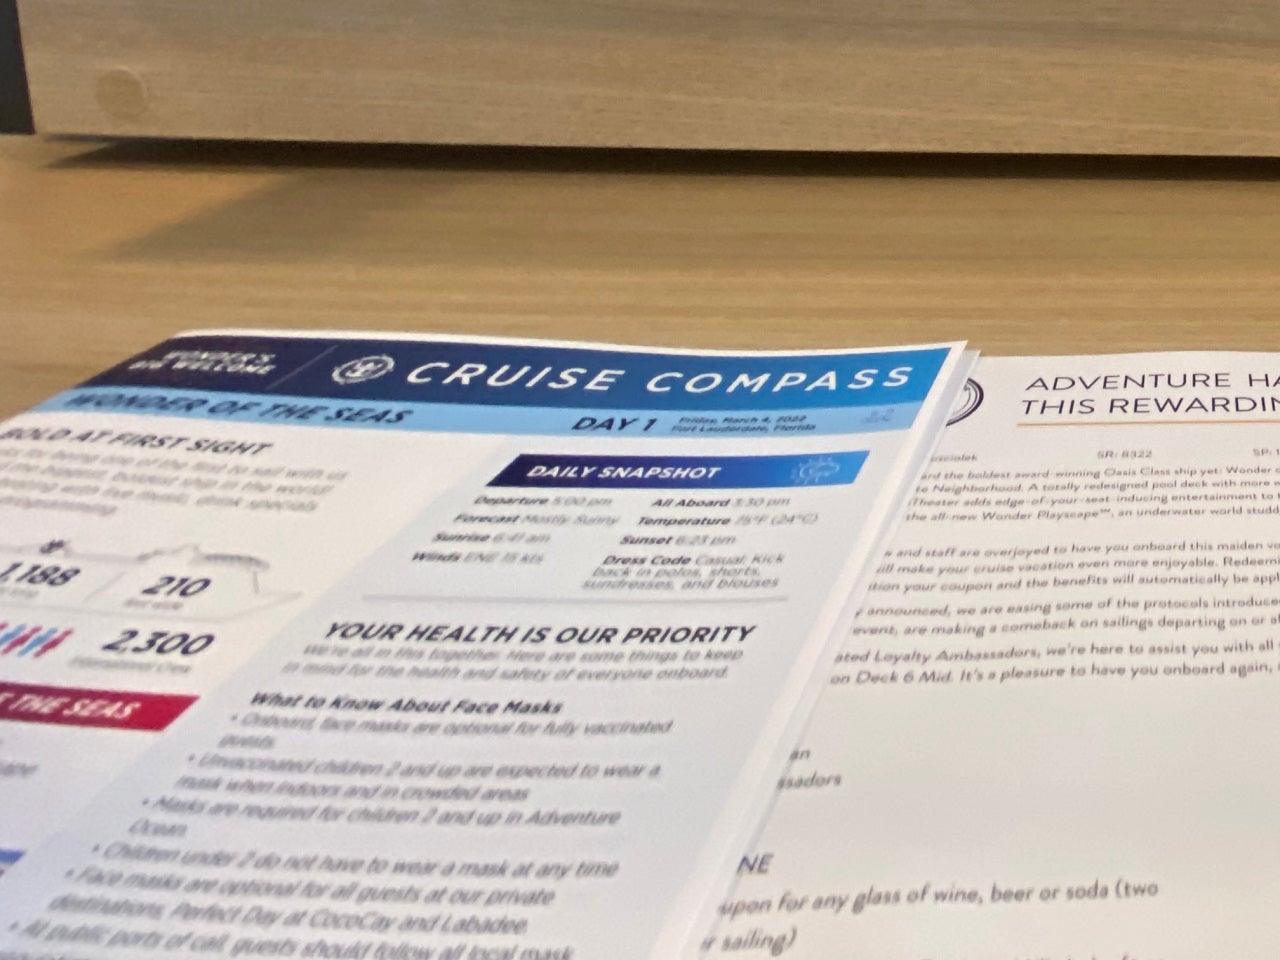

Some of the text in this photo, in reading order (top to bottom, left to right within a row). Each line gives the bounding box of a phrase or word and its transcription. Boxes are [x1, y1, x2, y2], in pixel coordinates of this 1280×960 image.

[407, 362, 911, 393] CRUISE COMPASS
[1026, 372, 1229, 391] ADVENTURE
[67, 393, 413, 424] WONDER OF THE SEAS
[1025, 398, 1095, 415] THIS
[571, 416, 658, 432] DAY 1
[670, 422, 816, 433] Fort Lauderdale, Florida
[721, 416, 758, 425] March
[760, 416, 771, 424] 4,
[775, 414, 807, 424] 2022
[0, 427, 273, 455] BOLD AT FIRST SIGHT
[526, 465, 719, 479] DAILY SNAPSHOT
[411, 551, 461, 562] Winds
[601, 554, 647, 568] Dress
[650, 555, 692, 566] Code
[750, 553, 784, 564] Kick
[140, 575, 212, 597] 210
[101, 629, 215, 654] 2,300
[325, 622, 755, 644] YOUR HEALTH IS OUR PRIORITY
[873, 649, 931, 665] Loyalty
[935, 646, 1041, 662] Ambassadors,
[1046, 642, 1086, 656] we're
[1089, 642, 1124, 655] here
[1128, 643, 1144, 655] to
[1148, 643, 1187, 655] assist
[1191, 645, 1219, 657] you
[1222, 639, 1254, 653] with
[1258, 638, 1274, 652] all
[829, 674, 851, 685] on
[855, 669, 898, 685] Deck
[902, 669, 915, 684] 6
[918, 670, 952, 684] Mid.
[959, 668, 984, 682] It's
[986, 670, 997, 681] a
[999, 666, 1065, 683] pleasure
[1070, 664, 1087, 677] to
[1090, 662, 1126, 676] have
[1130, 666, 1159, 680] you
[1162, 661, 1225, 676] onboard
[1229, 661, 1273, 677] again,
[62, 698, 142, 719] SEAS
[250, 692, 562, 714] What to Know About Face Masks
[776, 772, 843, 791] ssadors
[717, 878, 1159, 919] upon for any glass of wine, beer or soda (two
[721, 929, 797, 954] sailing)
